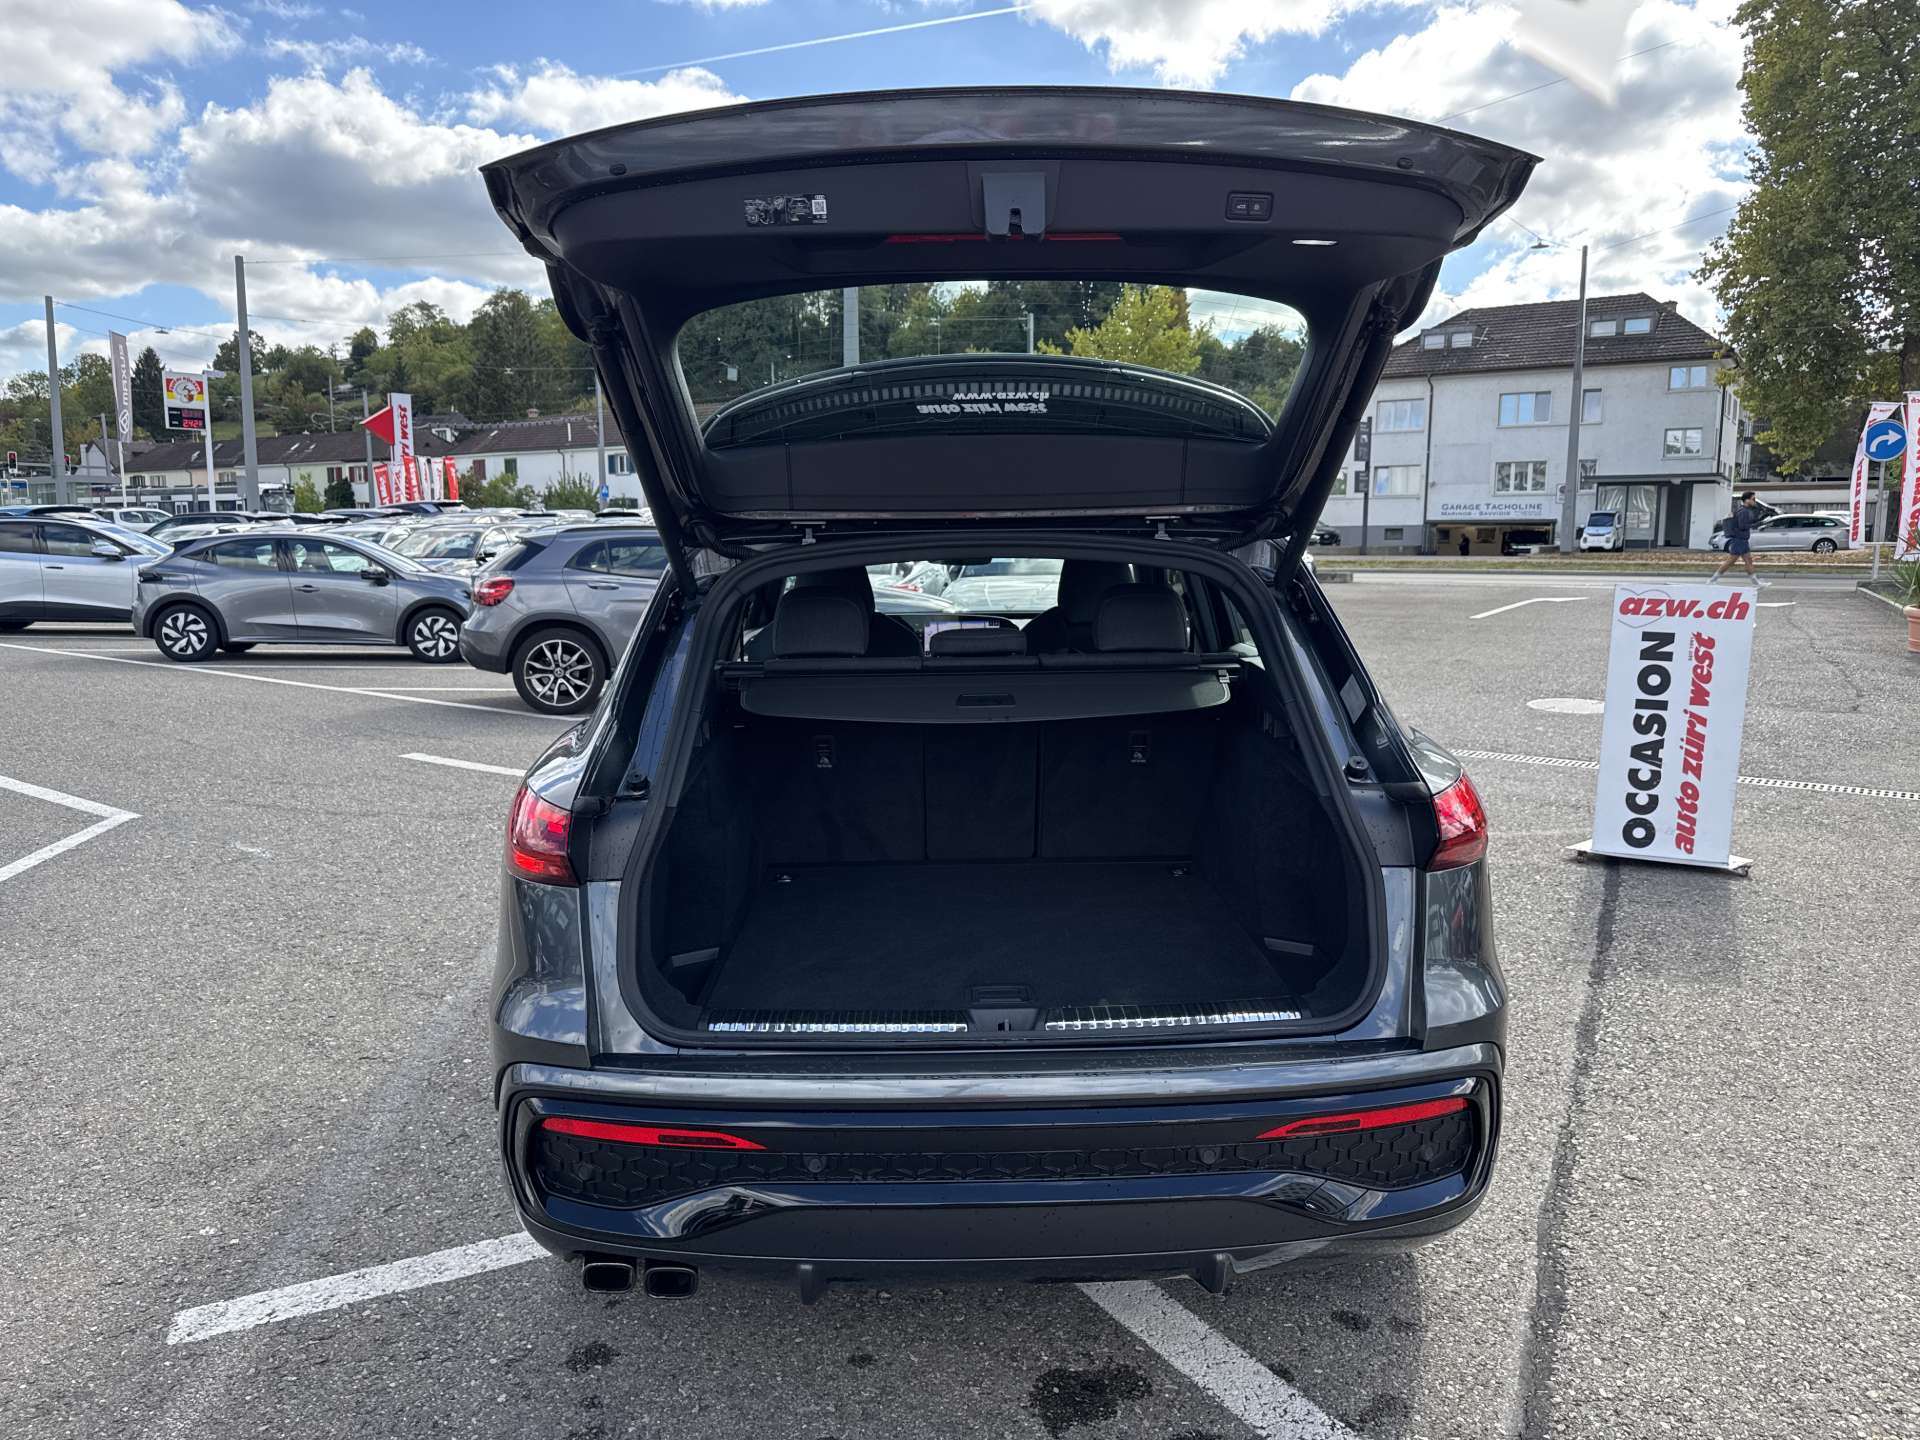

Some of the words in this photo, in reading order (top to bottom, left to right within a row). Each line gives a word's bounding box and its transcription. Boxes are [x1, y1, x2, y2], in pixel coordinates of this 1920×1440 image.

[398, 403, 409, 440] west
[1441, 503, 1481, 511] GARAGE
[1484, 502, 1543, 511] TACHOLINE
[1618, 592, 1751, 621] azw.ch
[1689, 631, 1716, 707] west
[1621, 631, 1676, 849] OCCASION
[1679, 709, 1708, 782] züri
[1674, 781, 1700, 855] auto
